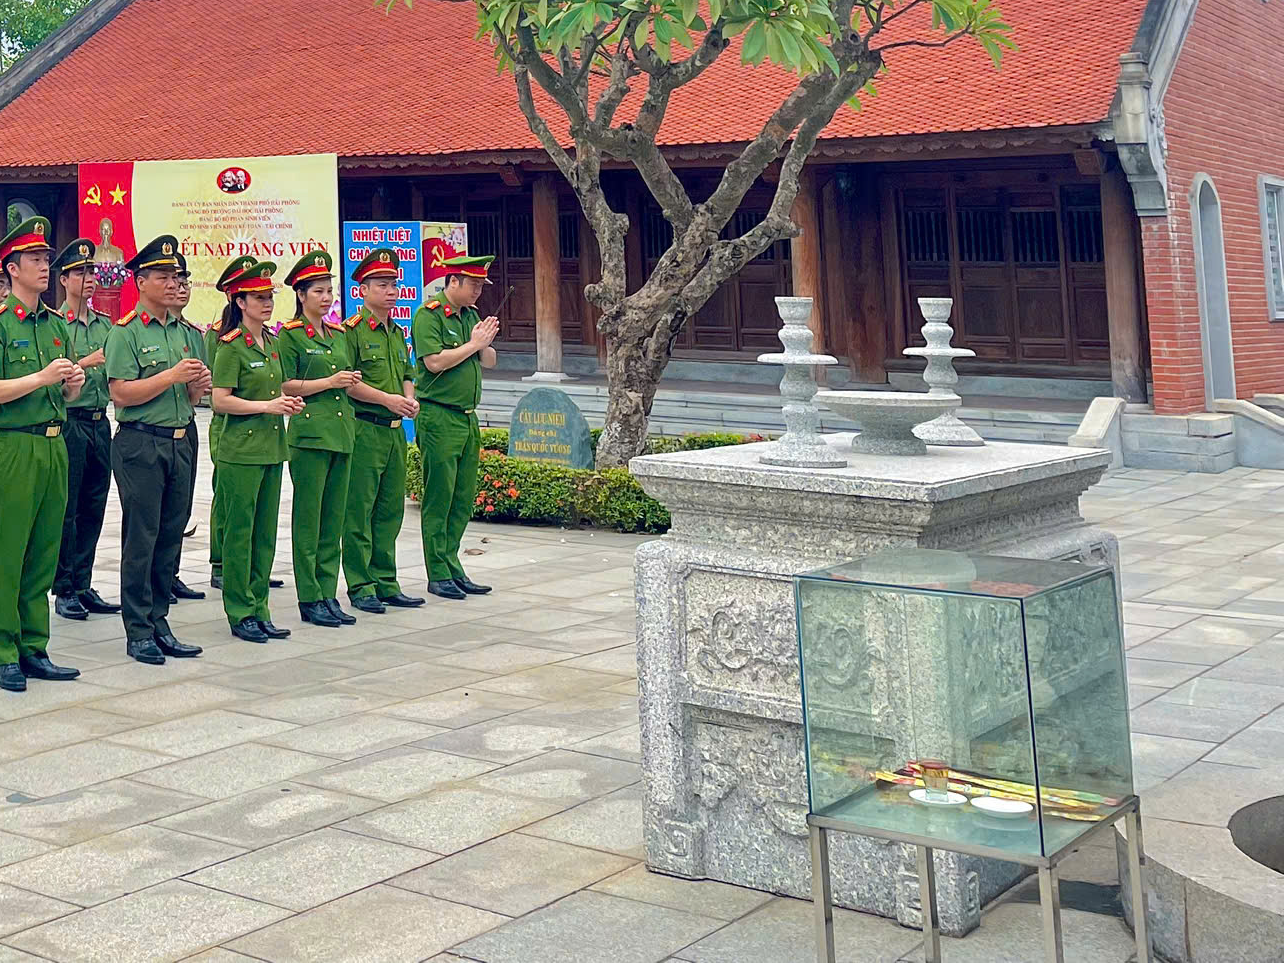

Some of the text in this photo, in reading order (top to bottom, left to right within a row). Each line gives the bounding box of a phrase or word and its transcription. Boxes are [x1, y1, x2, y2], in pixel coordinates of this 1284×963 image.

[353, 227, 411, 244] NHIỆT LIỆT
[204, 242, 235, 259] NẠP
[239, 237, 284, 256] ĐẢNG
[289, 238, 329, 256] VIÊN
[349, 247, 375, 260] CHÀ
